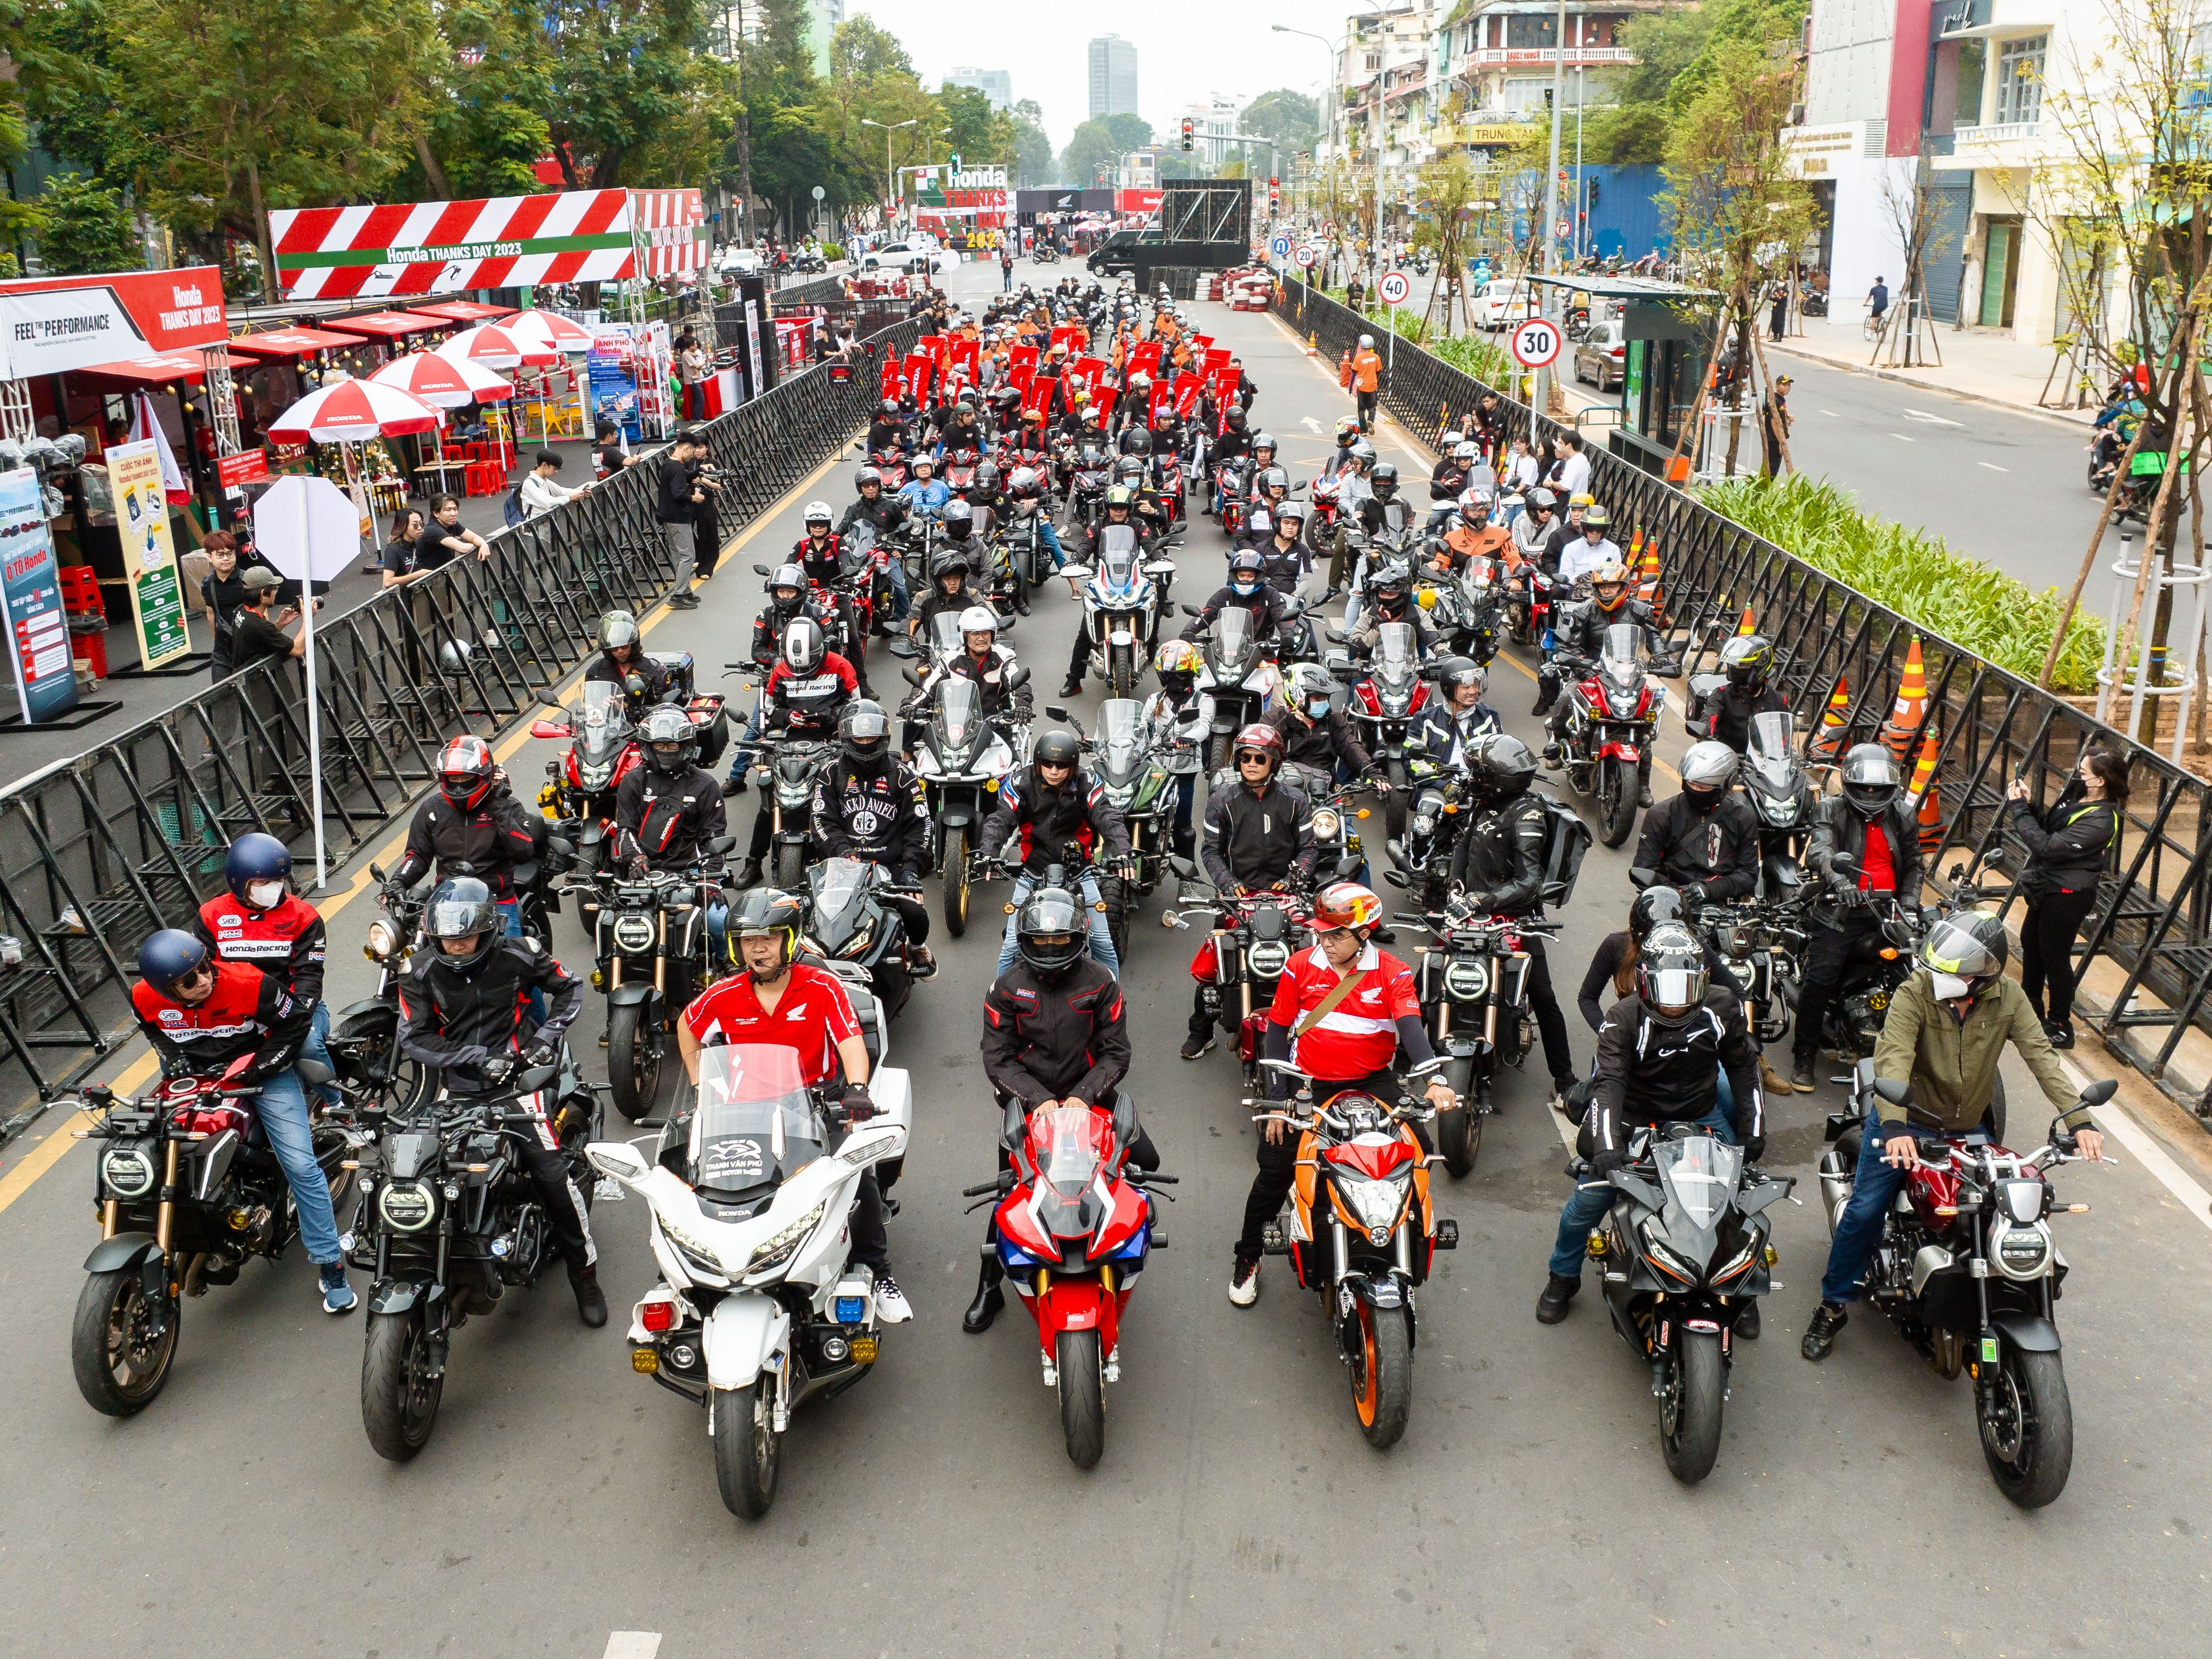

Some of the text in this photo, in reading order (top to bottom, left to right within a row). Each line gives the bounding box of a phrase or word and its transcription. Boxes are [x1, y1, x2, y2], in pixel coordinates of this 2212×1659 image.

[947, 166, 1006, 187] Honda
[944, 190, 1007, 207] THANKS
[978, 212, 1007, 228] DAY
[967, 233, 1005, 248] 202
[387, 242, 522, 263] Honda THANKS DAY 2023
[1300, 251, 1310, 261] 20
[173, 284, 202, 308] Honda
[1385, 281, 1402, 295] 40
[15, 321, 36, 341] FEEL
[45, 314, 109, 337] PERFORMANCE
[160, 305, 220, 331] THANKS DAY 2023
[1525, 332, 1549, 353] 30
[911, 366, 921, 396] ONDA
[1085, 370, 1094, 392] NDA
[1035, 389, 1044, 411] NDA
[1176, 386, 1192, 412] ONDA
[9, 503, 35, 516] PERFORMANCE
[6, 548, 47, 582] Ô TÔ Honda
[661, 817, 675, 841] HONDA
[220, 917, 238, 926] SHOEI
[218, 929, 243, 939] HRC
[226, 944, 290, 954] Honda Racing
[1689, 1320, 1719, 1329] MOTUL
